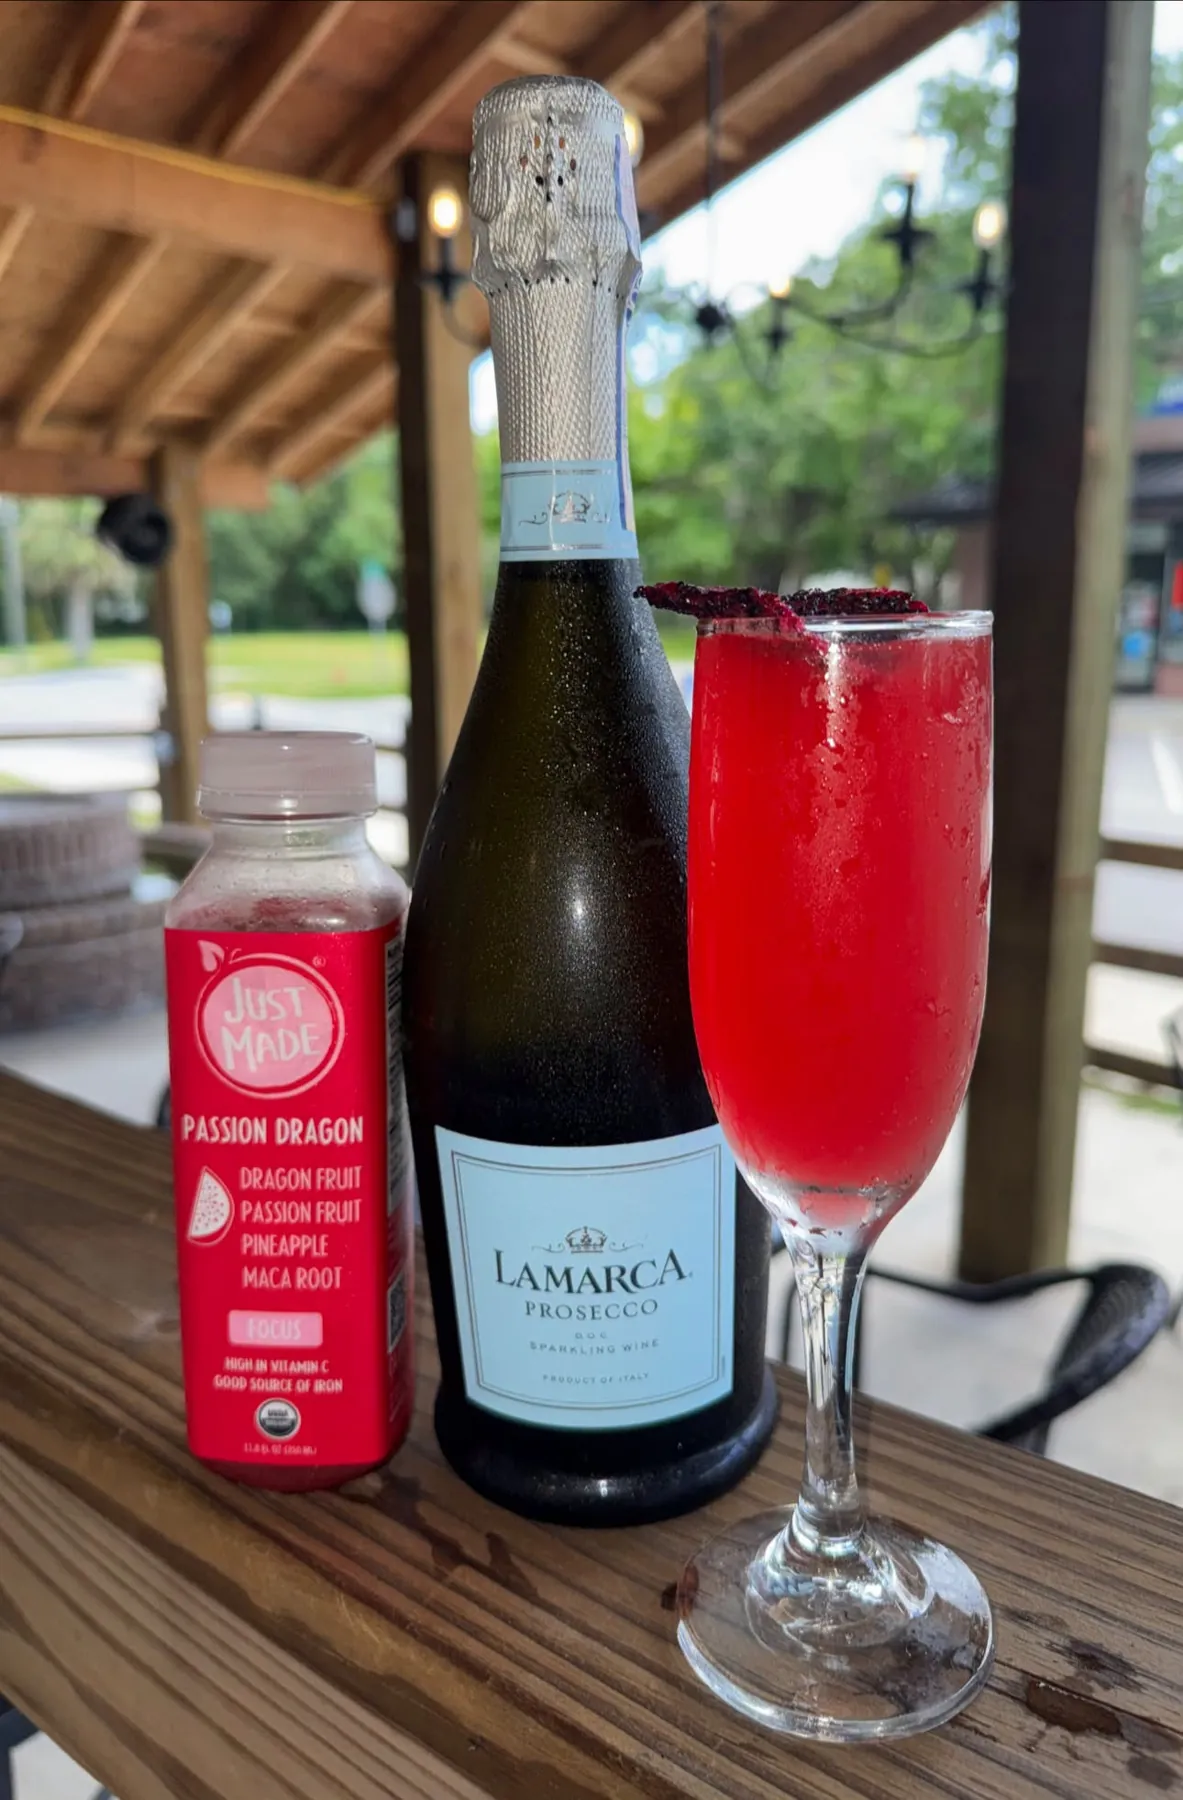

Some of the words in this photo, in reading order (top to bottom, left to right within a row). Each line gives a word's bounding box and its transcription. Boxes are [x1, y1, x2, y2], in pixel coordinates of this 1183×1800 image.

[224, 976, 306, 1023] JUST
[221, 1023, 320, 1073] MADE
[181, 1113, 267, 1144] PASSION
[275, 1115, 364, 1146] DRAGON
[239, 1166, 312, 1190] DRAGON
[315, 1165, 363, 1190] FRUIT
[240, 1199, 312, 1223] PASSION
[315, 1199, 363, 1223] FRUIT
[241, 1233, 329, 1257] PINEAPPLE
[242, 1266, 291, 1289] MACA
[295, 1266, 342, 1290] ROOT
[493, 1248, 688, 1294] LAMARCA
[525, 1298, 659, 1321] PROSECCO
[246, 1318, 302, 1341] FOCUS
[529, 1341, 616, 1355] SPARKLING
[622, 1339, 660, 1352] WINE
[224, 1356, 253, 1372] HIGH
[255, 1358, 268, 1373] IN
[270, 1359, 319, 1375] VITAMIN
[321, 1359, 330, 1373] C
[213, 1374, 248, 1391] GOOD
[249, 1377, 293, 1393] SOURCE
[295, 1378, 311, 1393] OF
[313, 1378, 344, 1394] IRON
[543, 1374, 596, 1385] PRODUCT
[600, 1376, 613, 1385] OF
[618, 1373, 649, 1382] ITALY
